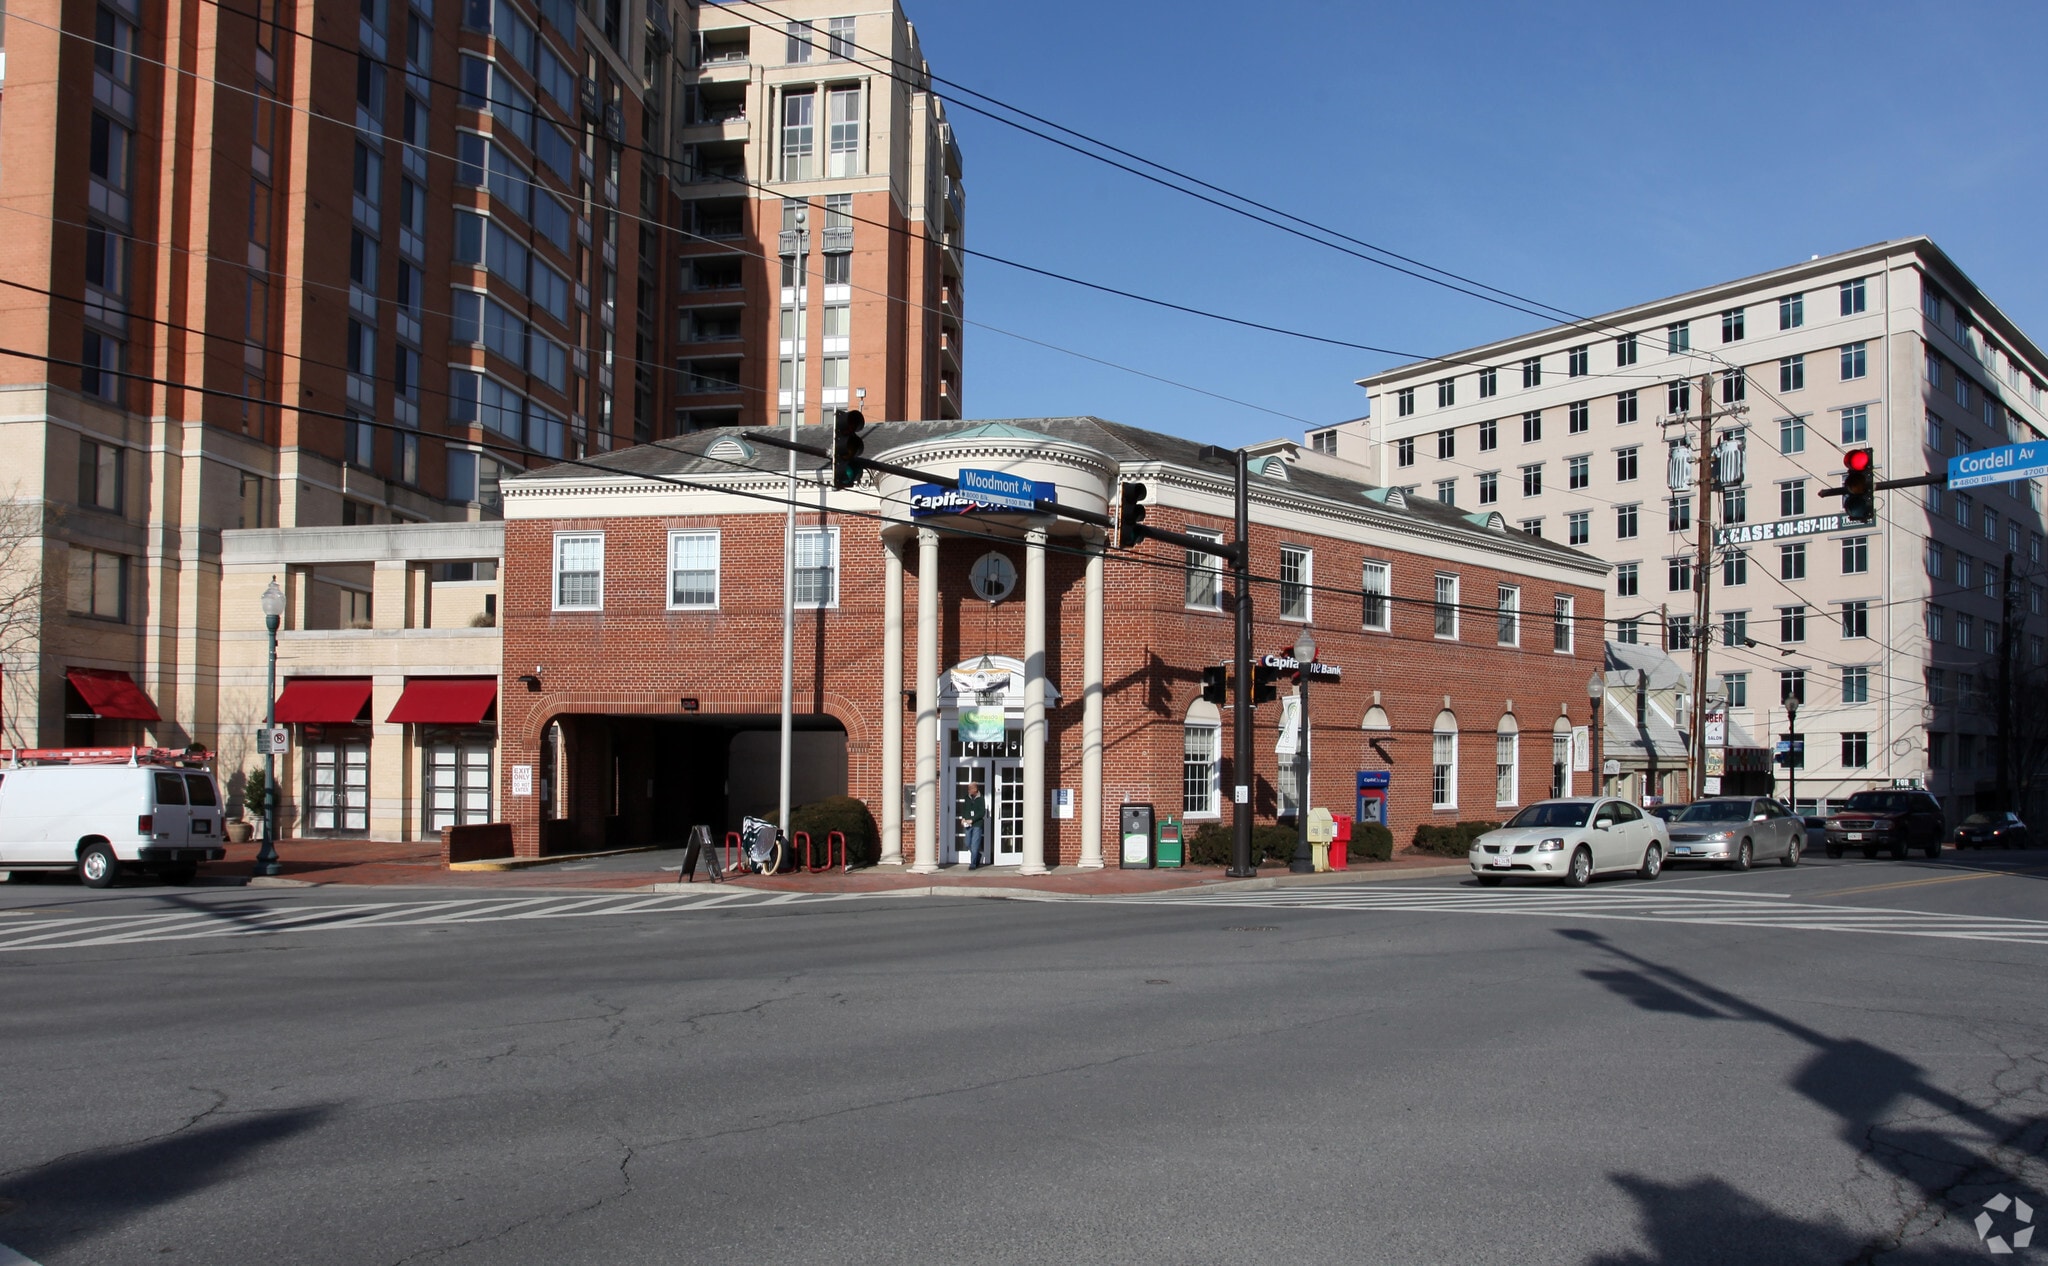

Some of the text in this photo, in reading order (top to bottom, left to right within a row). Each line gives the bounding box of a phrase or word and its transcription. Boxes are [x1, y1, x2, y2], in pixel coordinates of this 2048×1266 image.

[1960, 448, 2035, 473] Cordell Av
[966, 471, 1032, 494] Woodmont Av
[1959, 477, 1979, 486] 4800
[2023, 467, 2044, 477] 4700
[1777, 516, 1838, 537] 301-657-1112
[1321, 664, 1342, 675] Bank
